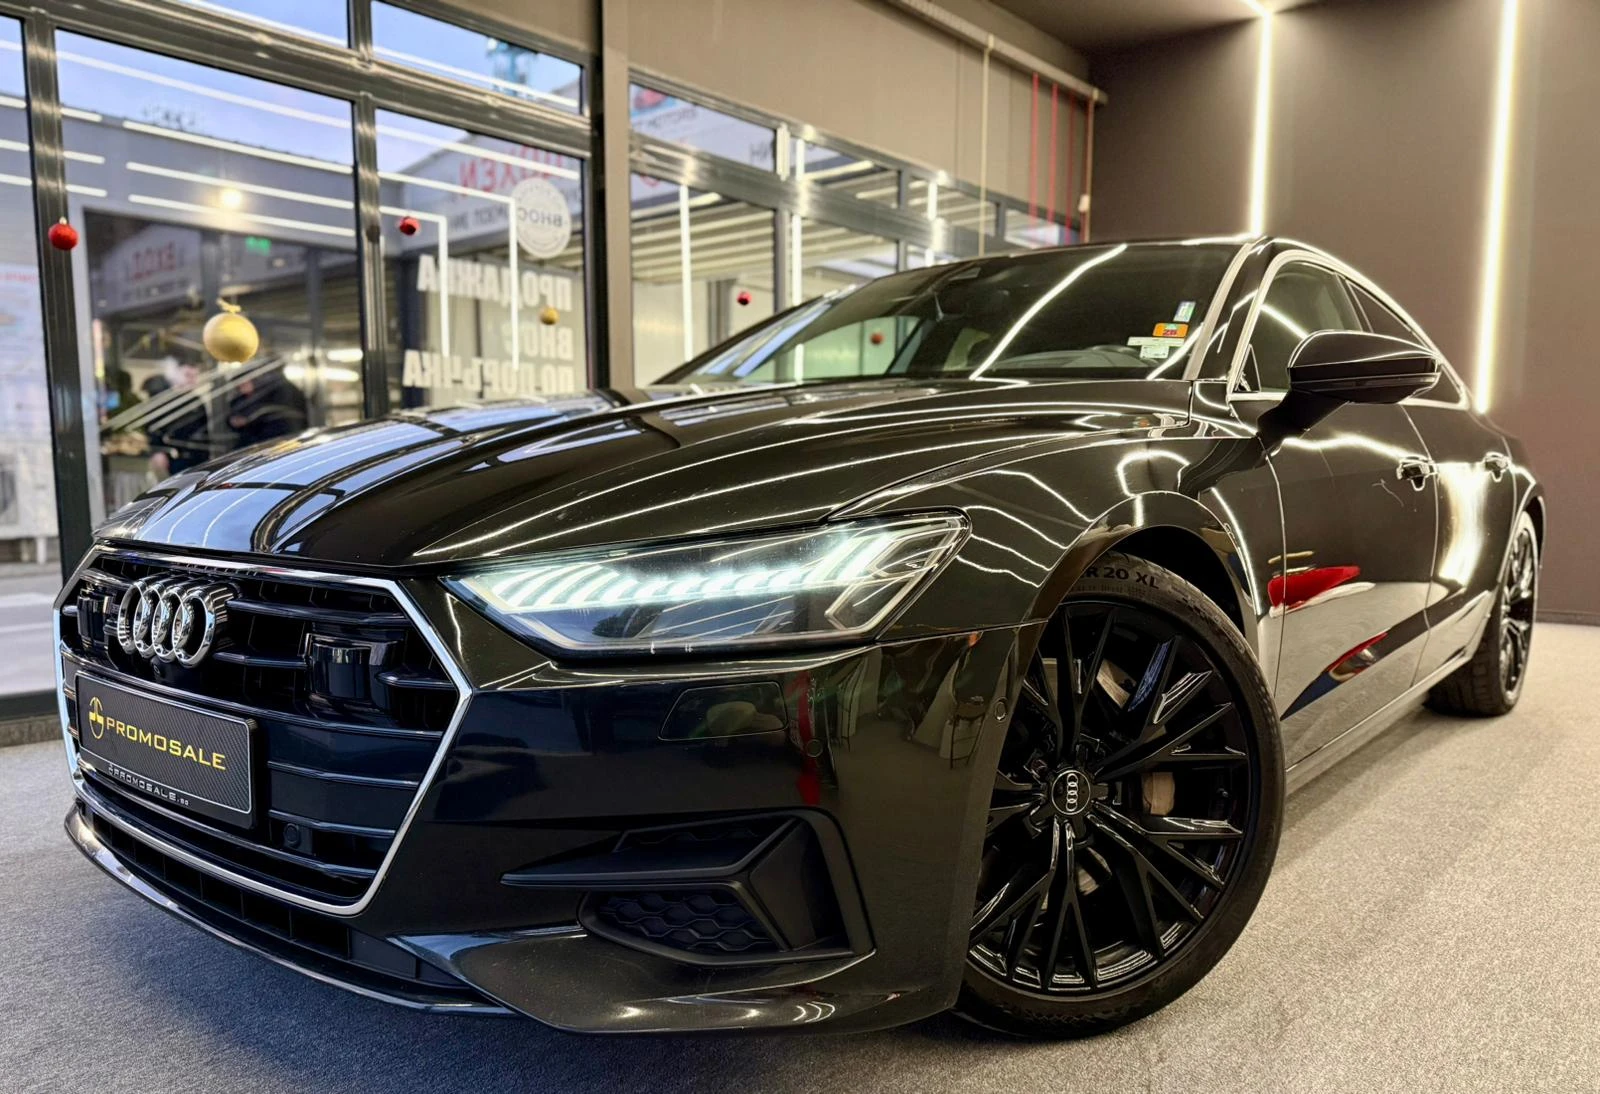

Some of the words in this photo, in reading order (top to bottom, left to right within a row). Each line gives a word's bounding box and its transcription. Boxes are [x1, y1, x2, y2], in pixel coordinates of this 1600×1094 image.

[1103, 566, 1129, 580] 20
[1135, 571, 1160, 590] XL
[106, 718, 226, 770] PROMOSALE
